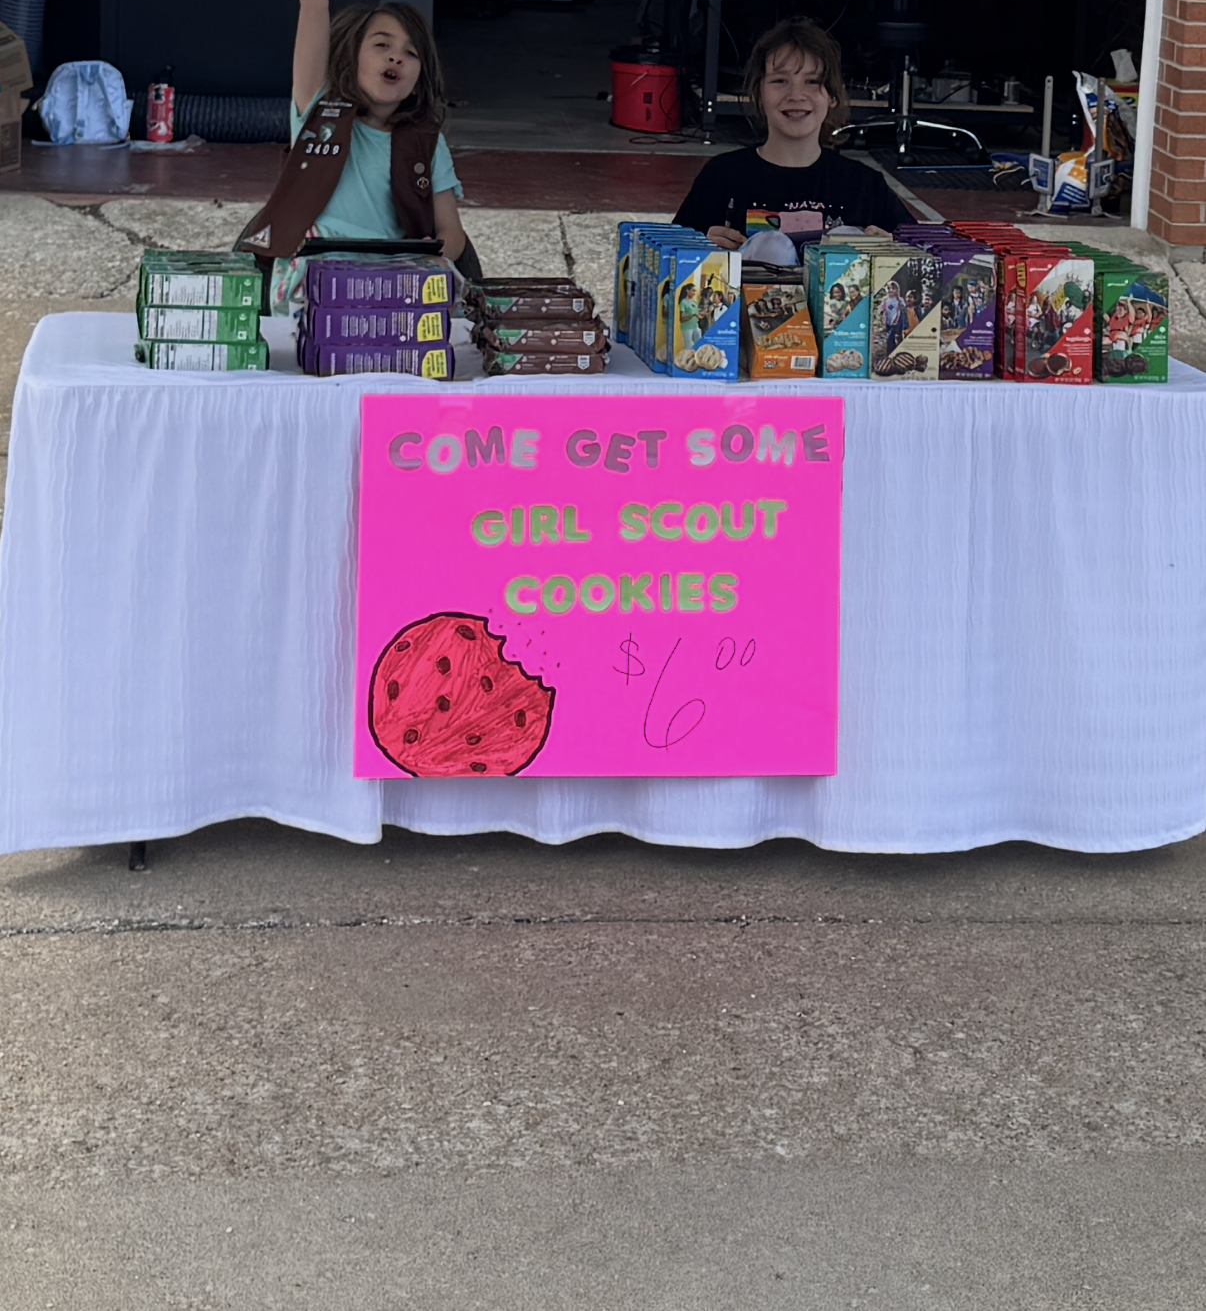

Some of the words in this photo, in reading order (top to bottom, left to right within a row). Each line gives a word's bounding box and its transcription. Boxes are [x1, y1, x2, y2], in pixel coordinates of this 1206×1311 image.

[306, 143, 340, 155] 3409
[388, 425, 540, 474] COME
[566, 429, 667, 474] GET
[687, 423, 831, 467] SOME
[471, 504, 591, 546] GIRL
[619, 499, 788, 542] SCOUT
[505, 573, 739, 615] COOKIES
